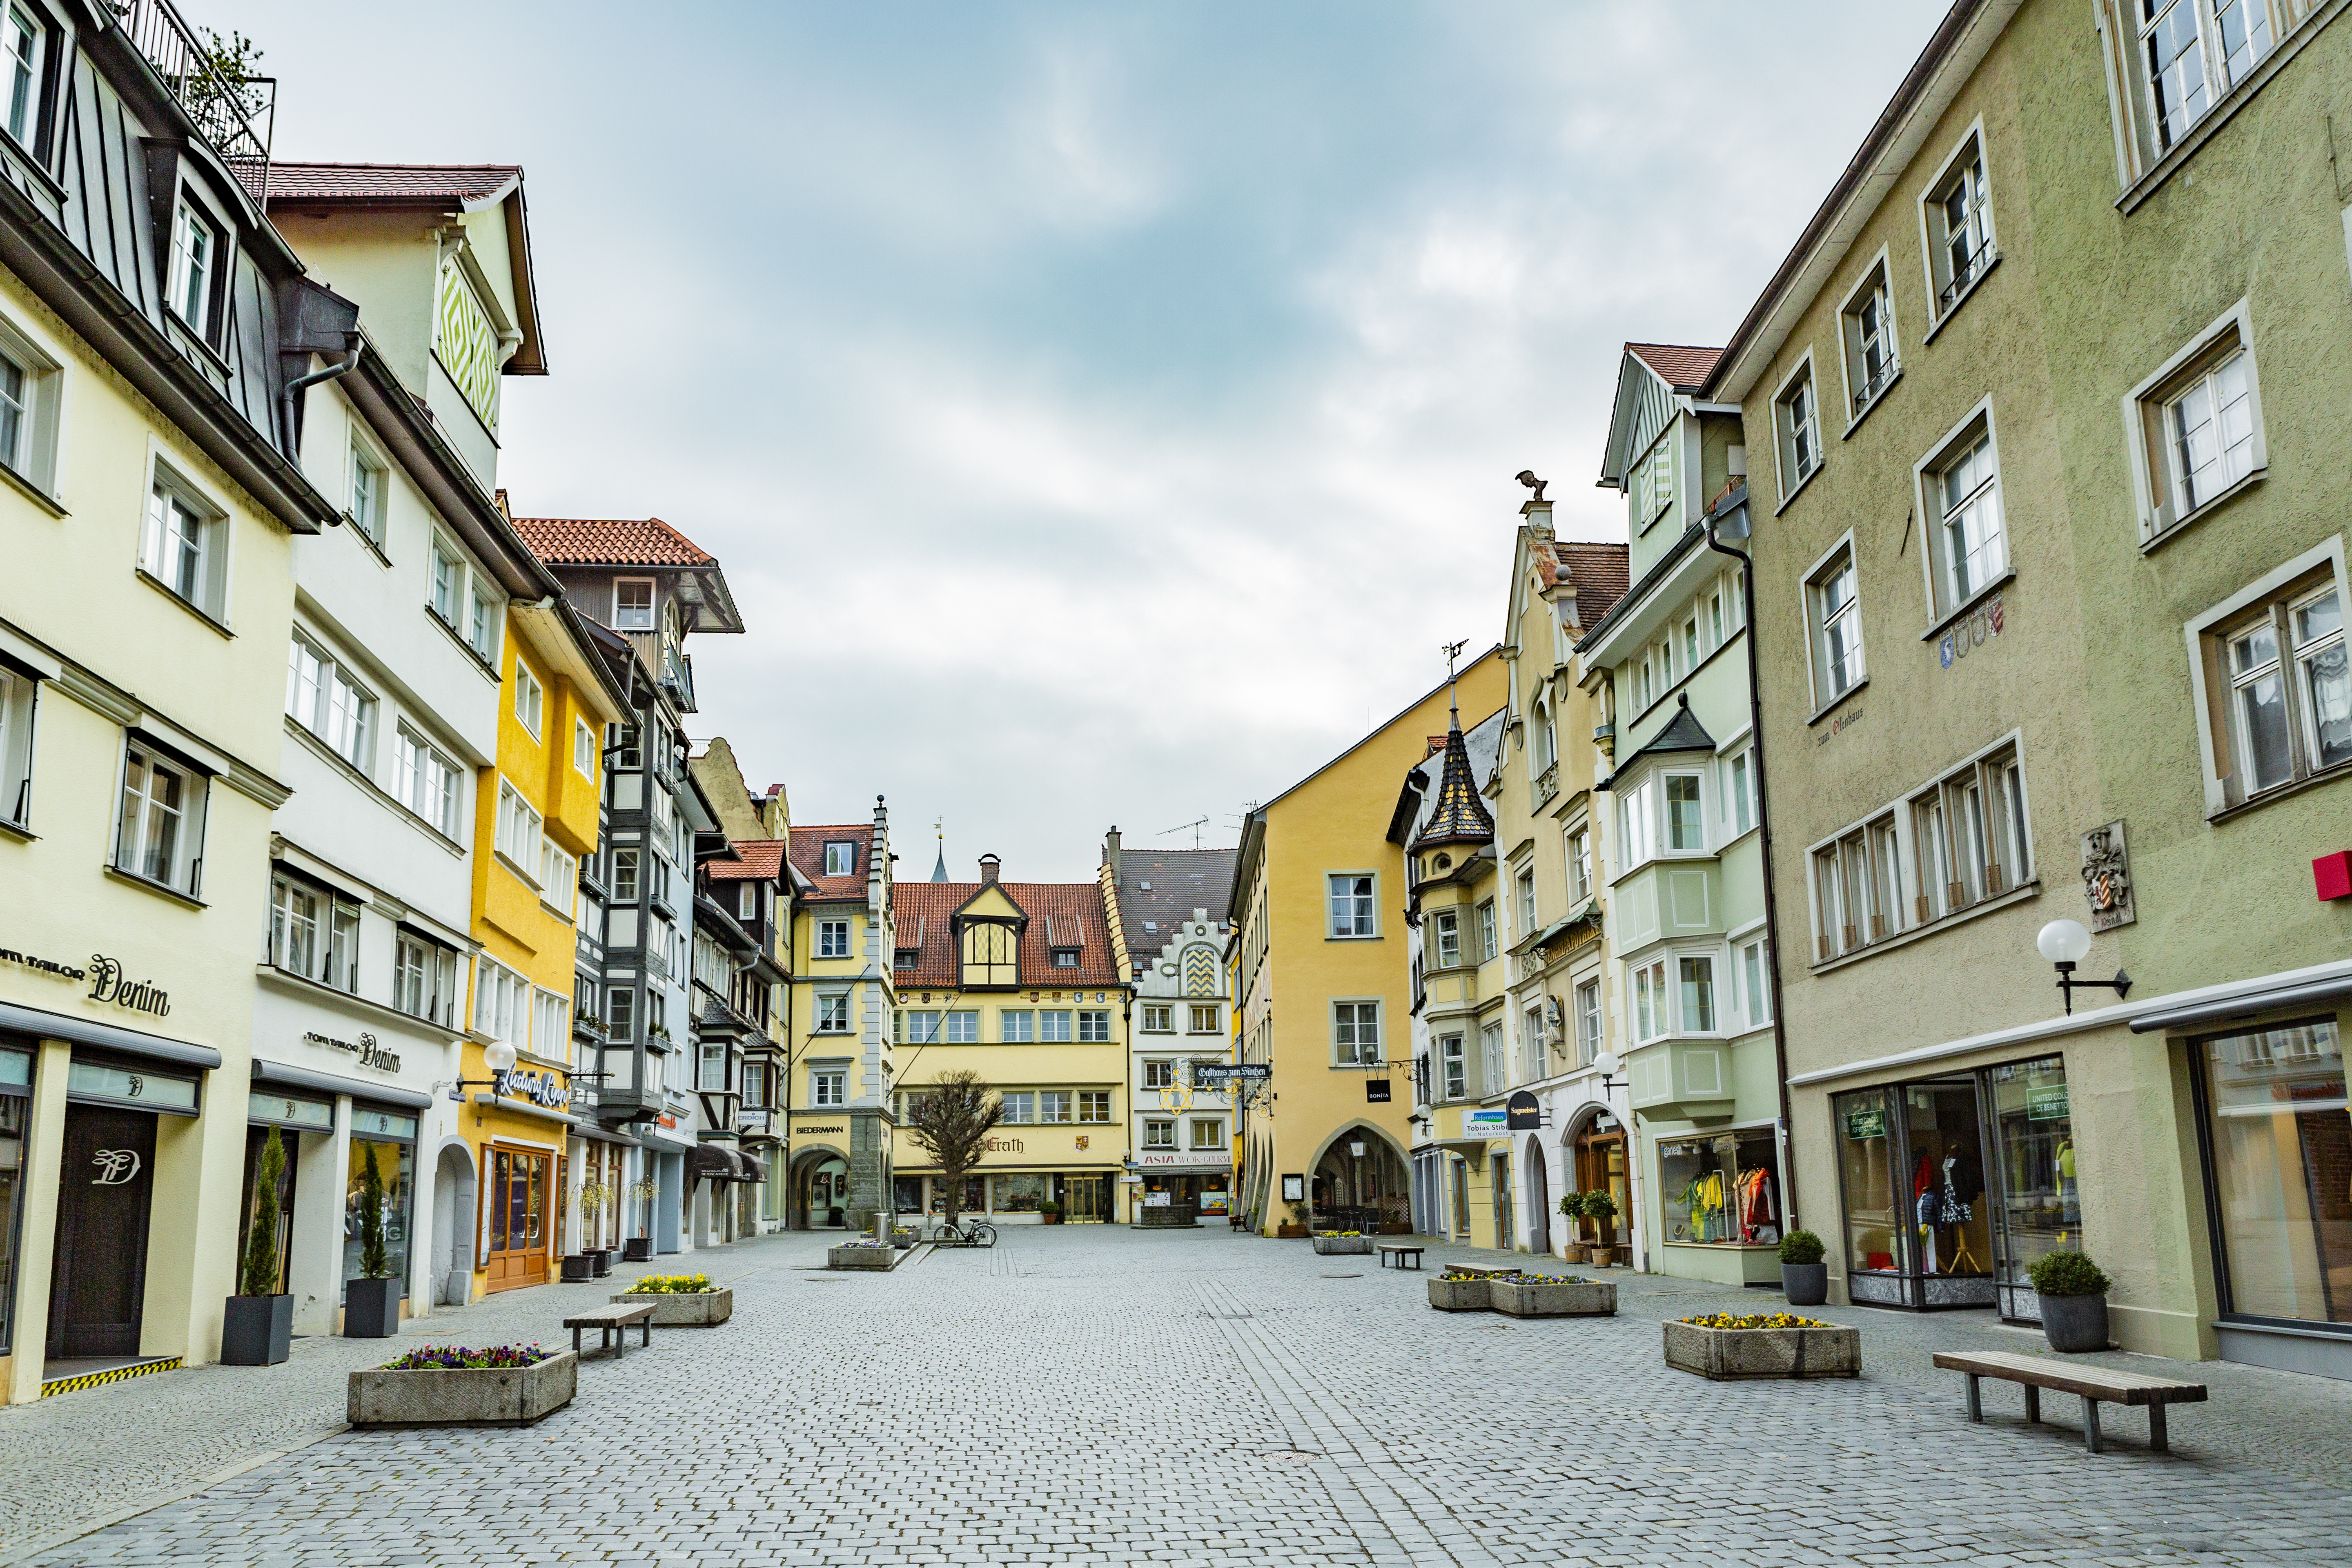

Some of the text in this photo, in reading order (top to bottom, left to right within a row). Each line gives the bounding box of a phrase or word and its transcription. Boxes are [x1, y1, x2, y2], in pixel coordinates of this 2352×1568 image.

[26, 956, 86, 981] TAILOR
[88, 954, 171, 1017] Denim
[307, 1032, 401, 1073] TOM TAILOR Denim
[1198, 1067, 1227, 1077] Gasthaus
[499, 1061, 568, 1107] Ludwig Lipp
[2032, 1094, 2052, 1102] UNITED
[1511, 1107, 1538, 1116] Sagmeister
[987, 1137, 1026, 1155] Erath
